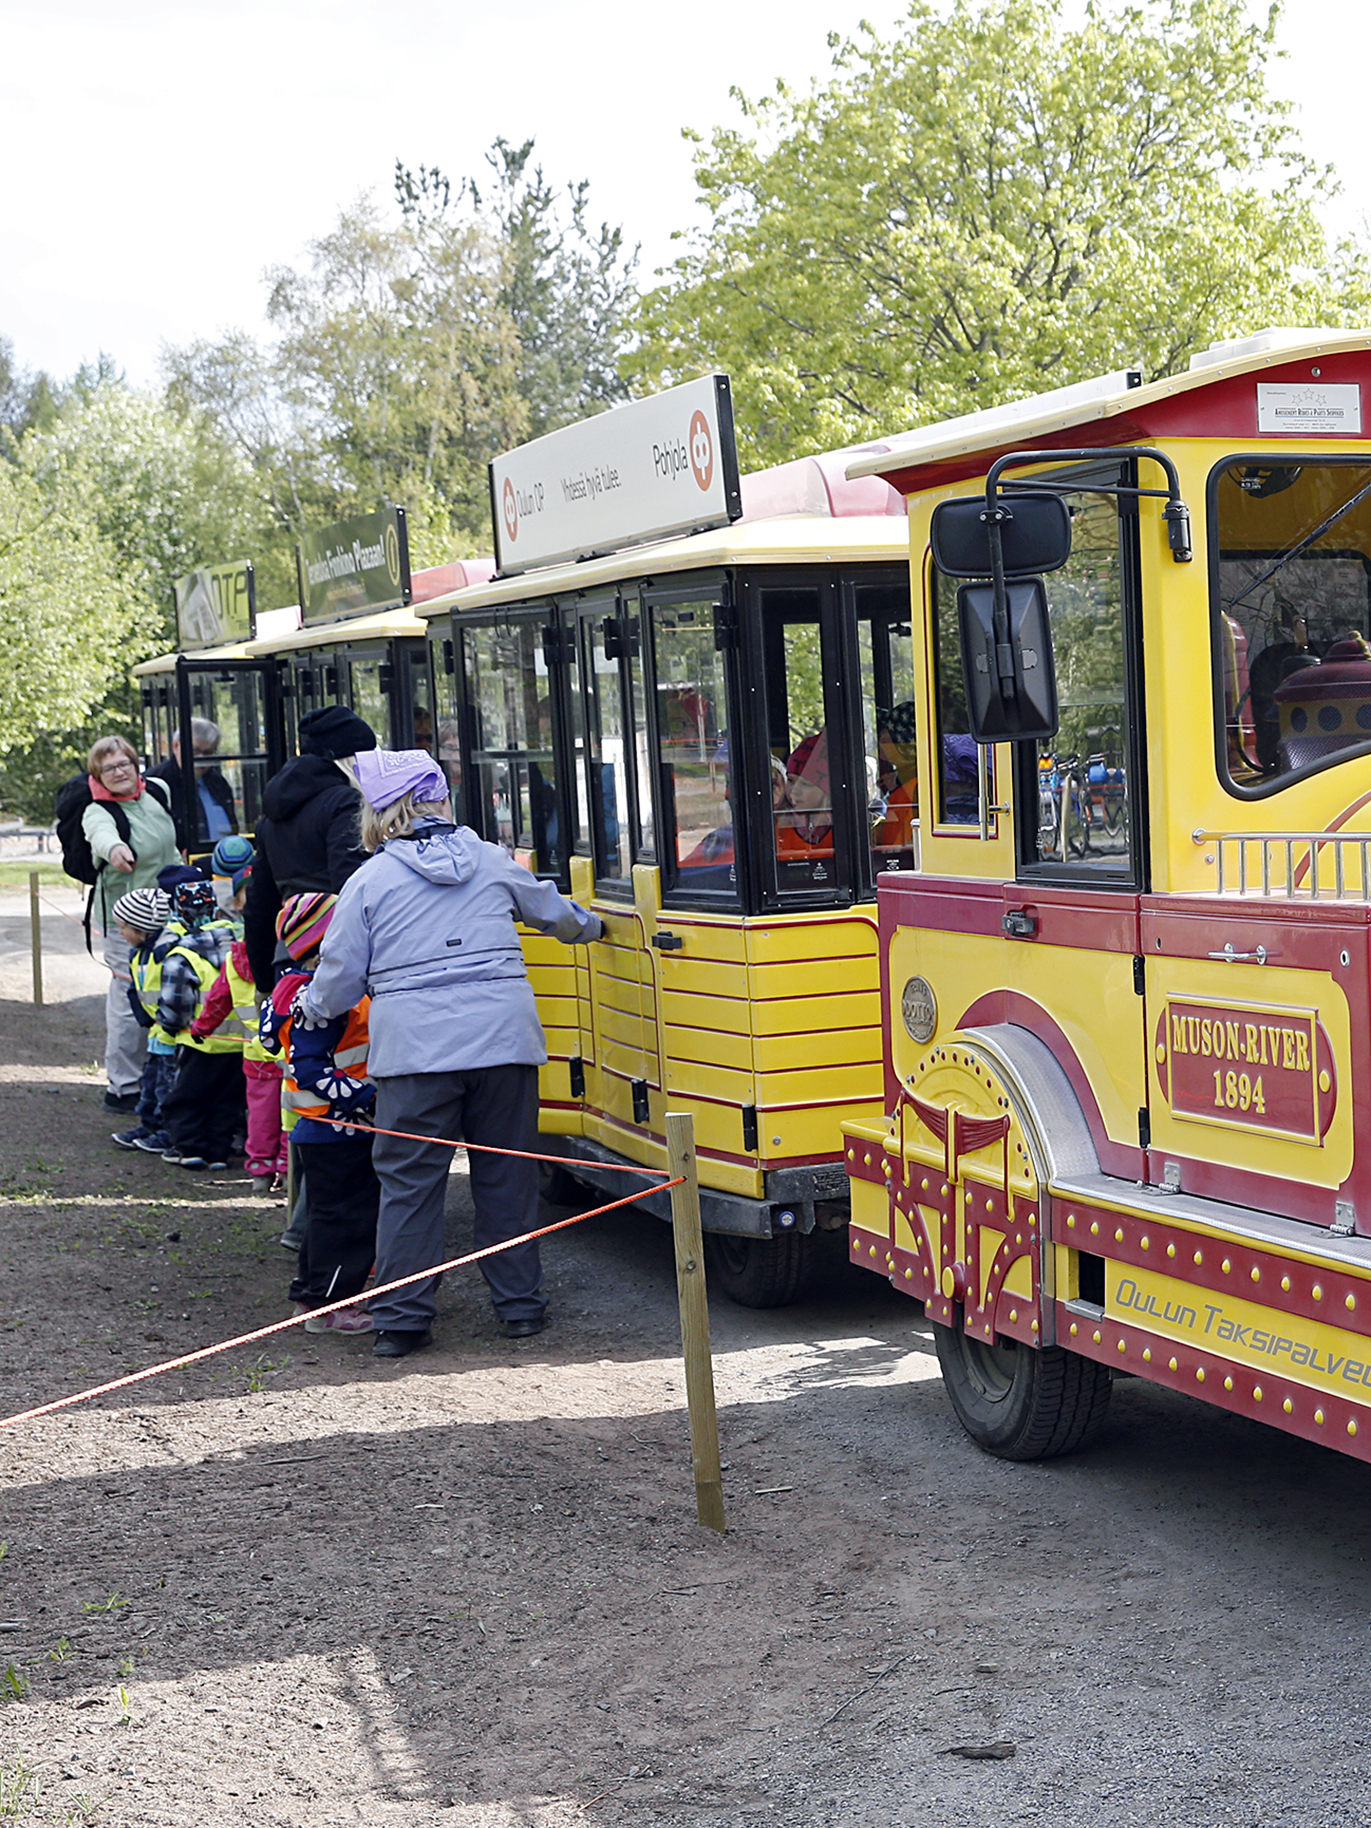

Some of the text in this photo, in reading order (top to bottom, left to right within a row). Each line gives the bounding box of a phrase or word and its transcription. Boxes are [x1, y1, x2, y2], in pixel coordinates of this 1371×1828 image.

[652, 438, 689, 481] Pohjola
[533, 482, 545, 513] OP
[1213, 1070, 1266, 1114] 1894
[1115, 1278, 1197, 1328] Oulun
